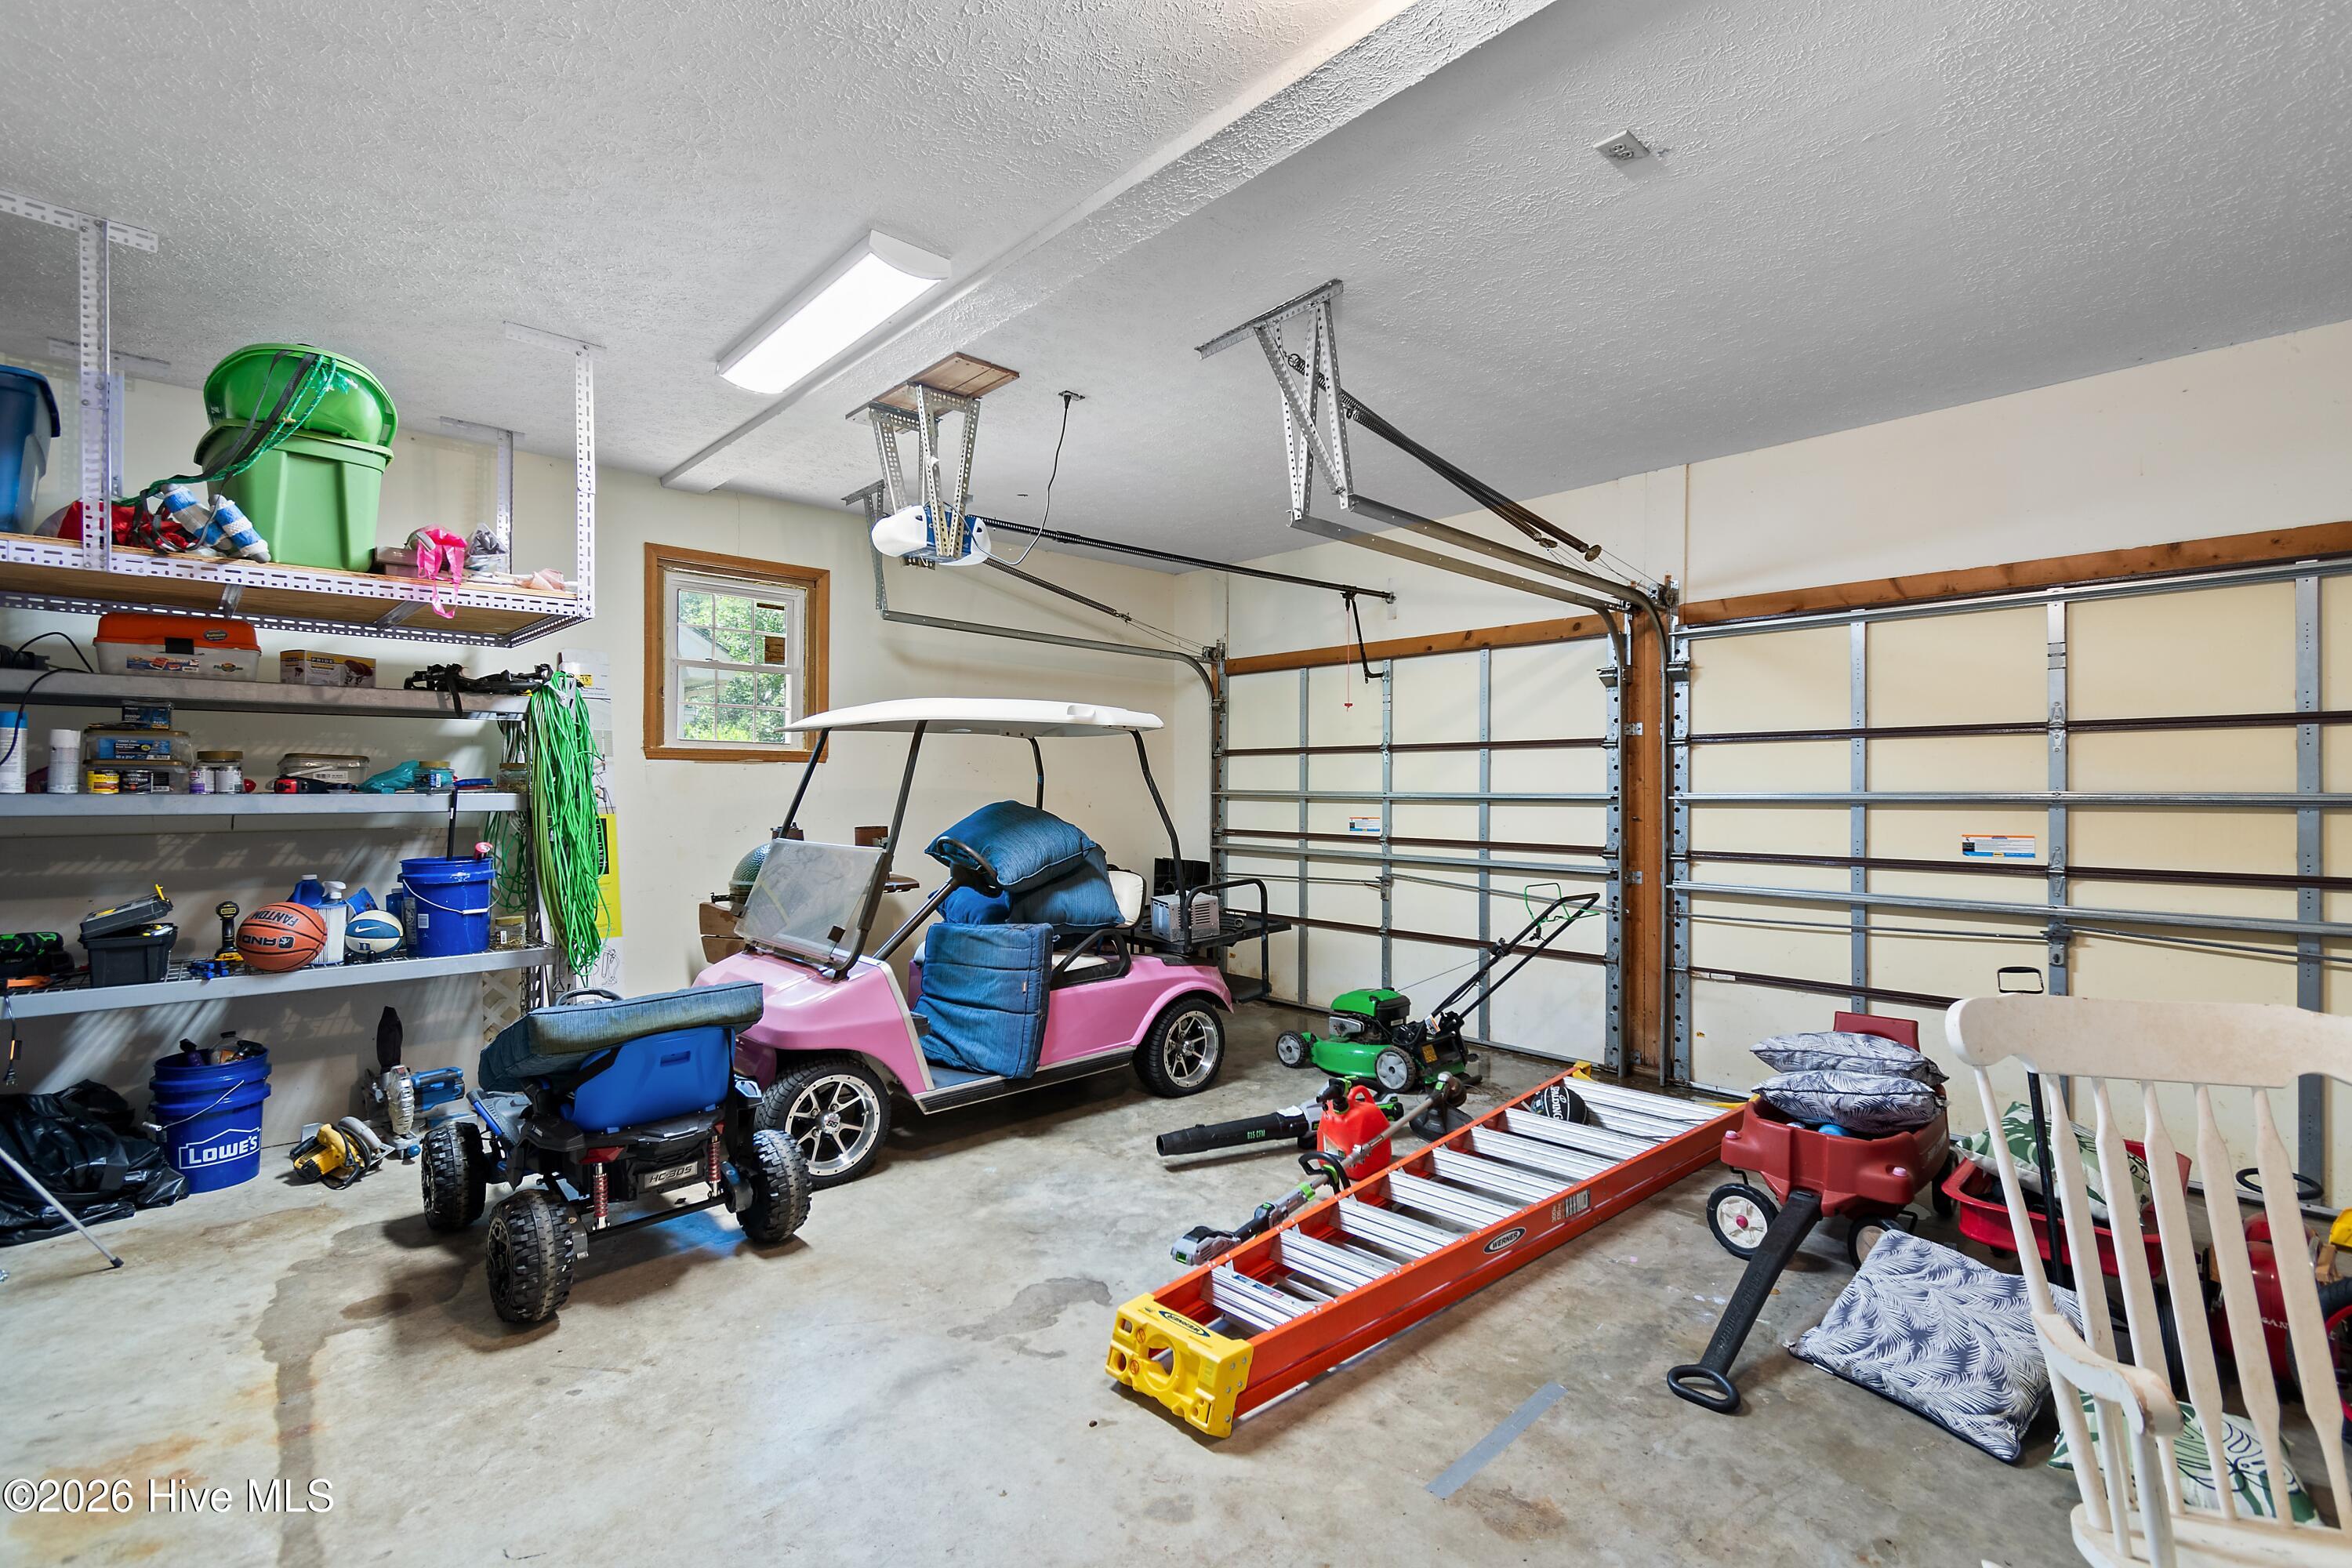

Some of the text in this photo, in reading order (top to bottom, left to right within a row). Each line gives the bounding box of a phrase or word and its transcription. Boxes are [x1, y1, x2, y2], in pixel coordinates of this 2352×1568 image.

[250, 909, 300, 927] FANTOM
[1550, 1084, 1564, 1120] PALDING
[1247, 1129, 1265, 1140] 615 CFM
[188, 1135, 258, 1165] LOWE'S
[1492, 1231, 1519, 1249] WERNER
